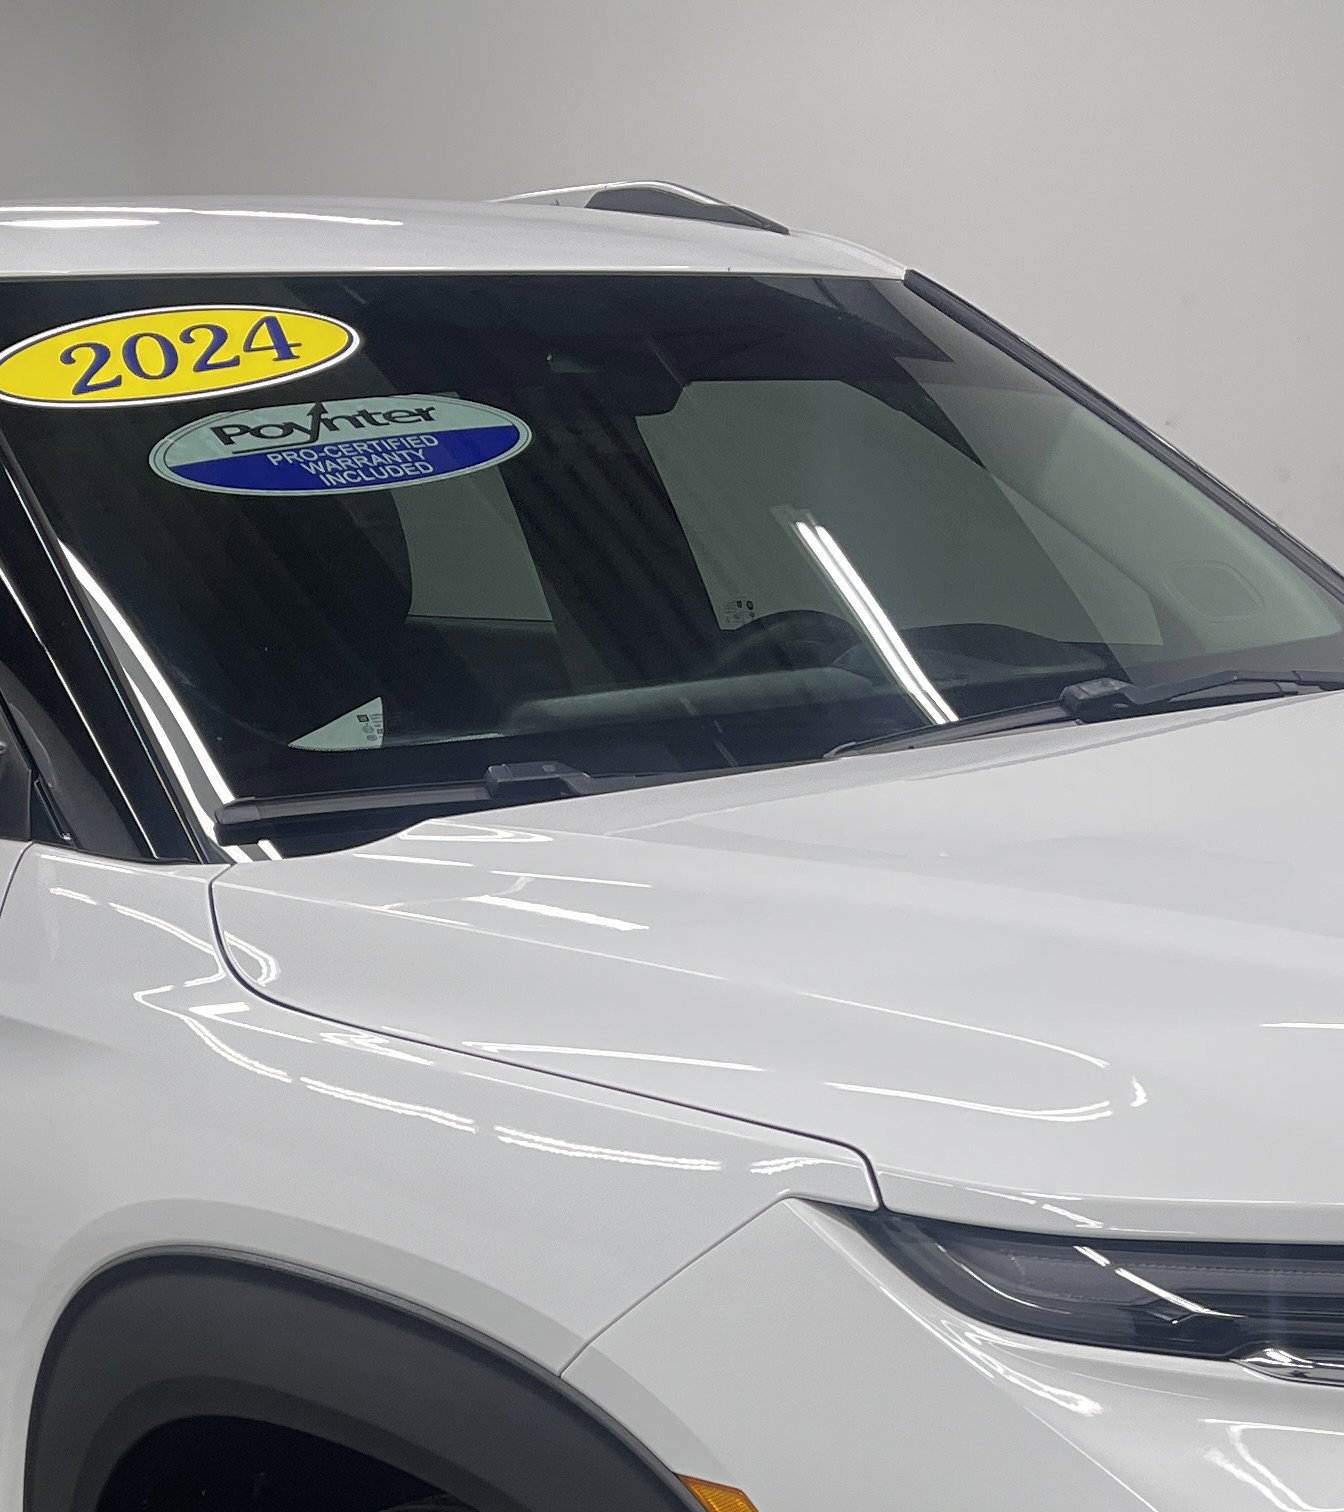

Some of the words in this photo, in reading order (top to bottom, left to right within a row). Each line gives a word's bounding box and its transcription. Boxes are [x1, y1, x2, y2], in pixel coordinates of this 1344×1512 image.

[59, 314, 303, 396] 2024
[210, 401, 436, 446] Poynter
[266, 434, 439, 467] PRO-CERTIFIED
[300, 448, 426, 476] WARRANTY
[319, 461, 434, 487] INCLUDED
